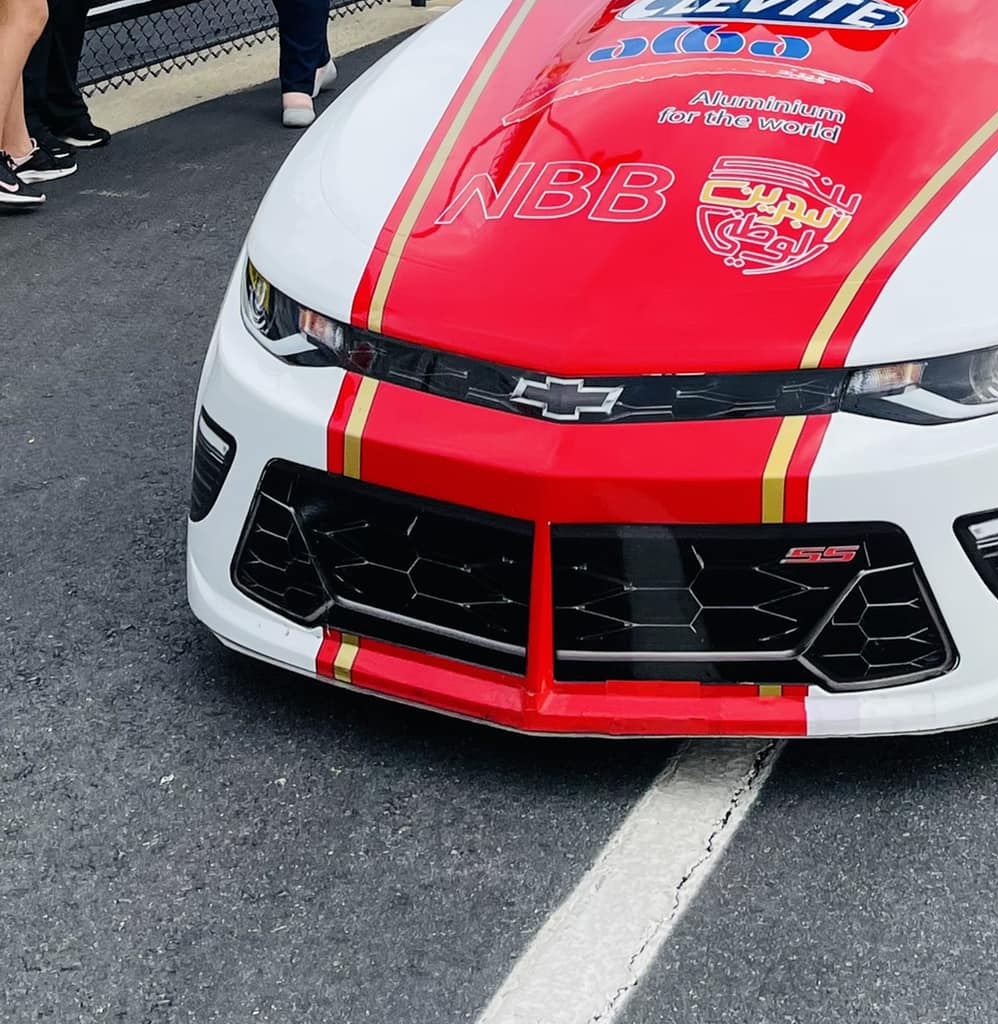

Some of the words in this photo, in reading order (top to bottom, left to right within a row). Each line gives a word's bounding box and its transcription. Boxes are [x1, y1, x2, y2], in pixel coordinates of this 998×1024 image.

[689, 88, 846, 125] Aluminium
[657, 107, 701, 125] for
[703, 107, 751, 129] the
[758, 118, 842, 144] world
[434, 161, 675, 225] NBB
[779, 544, 860, 564] SS
